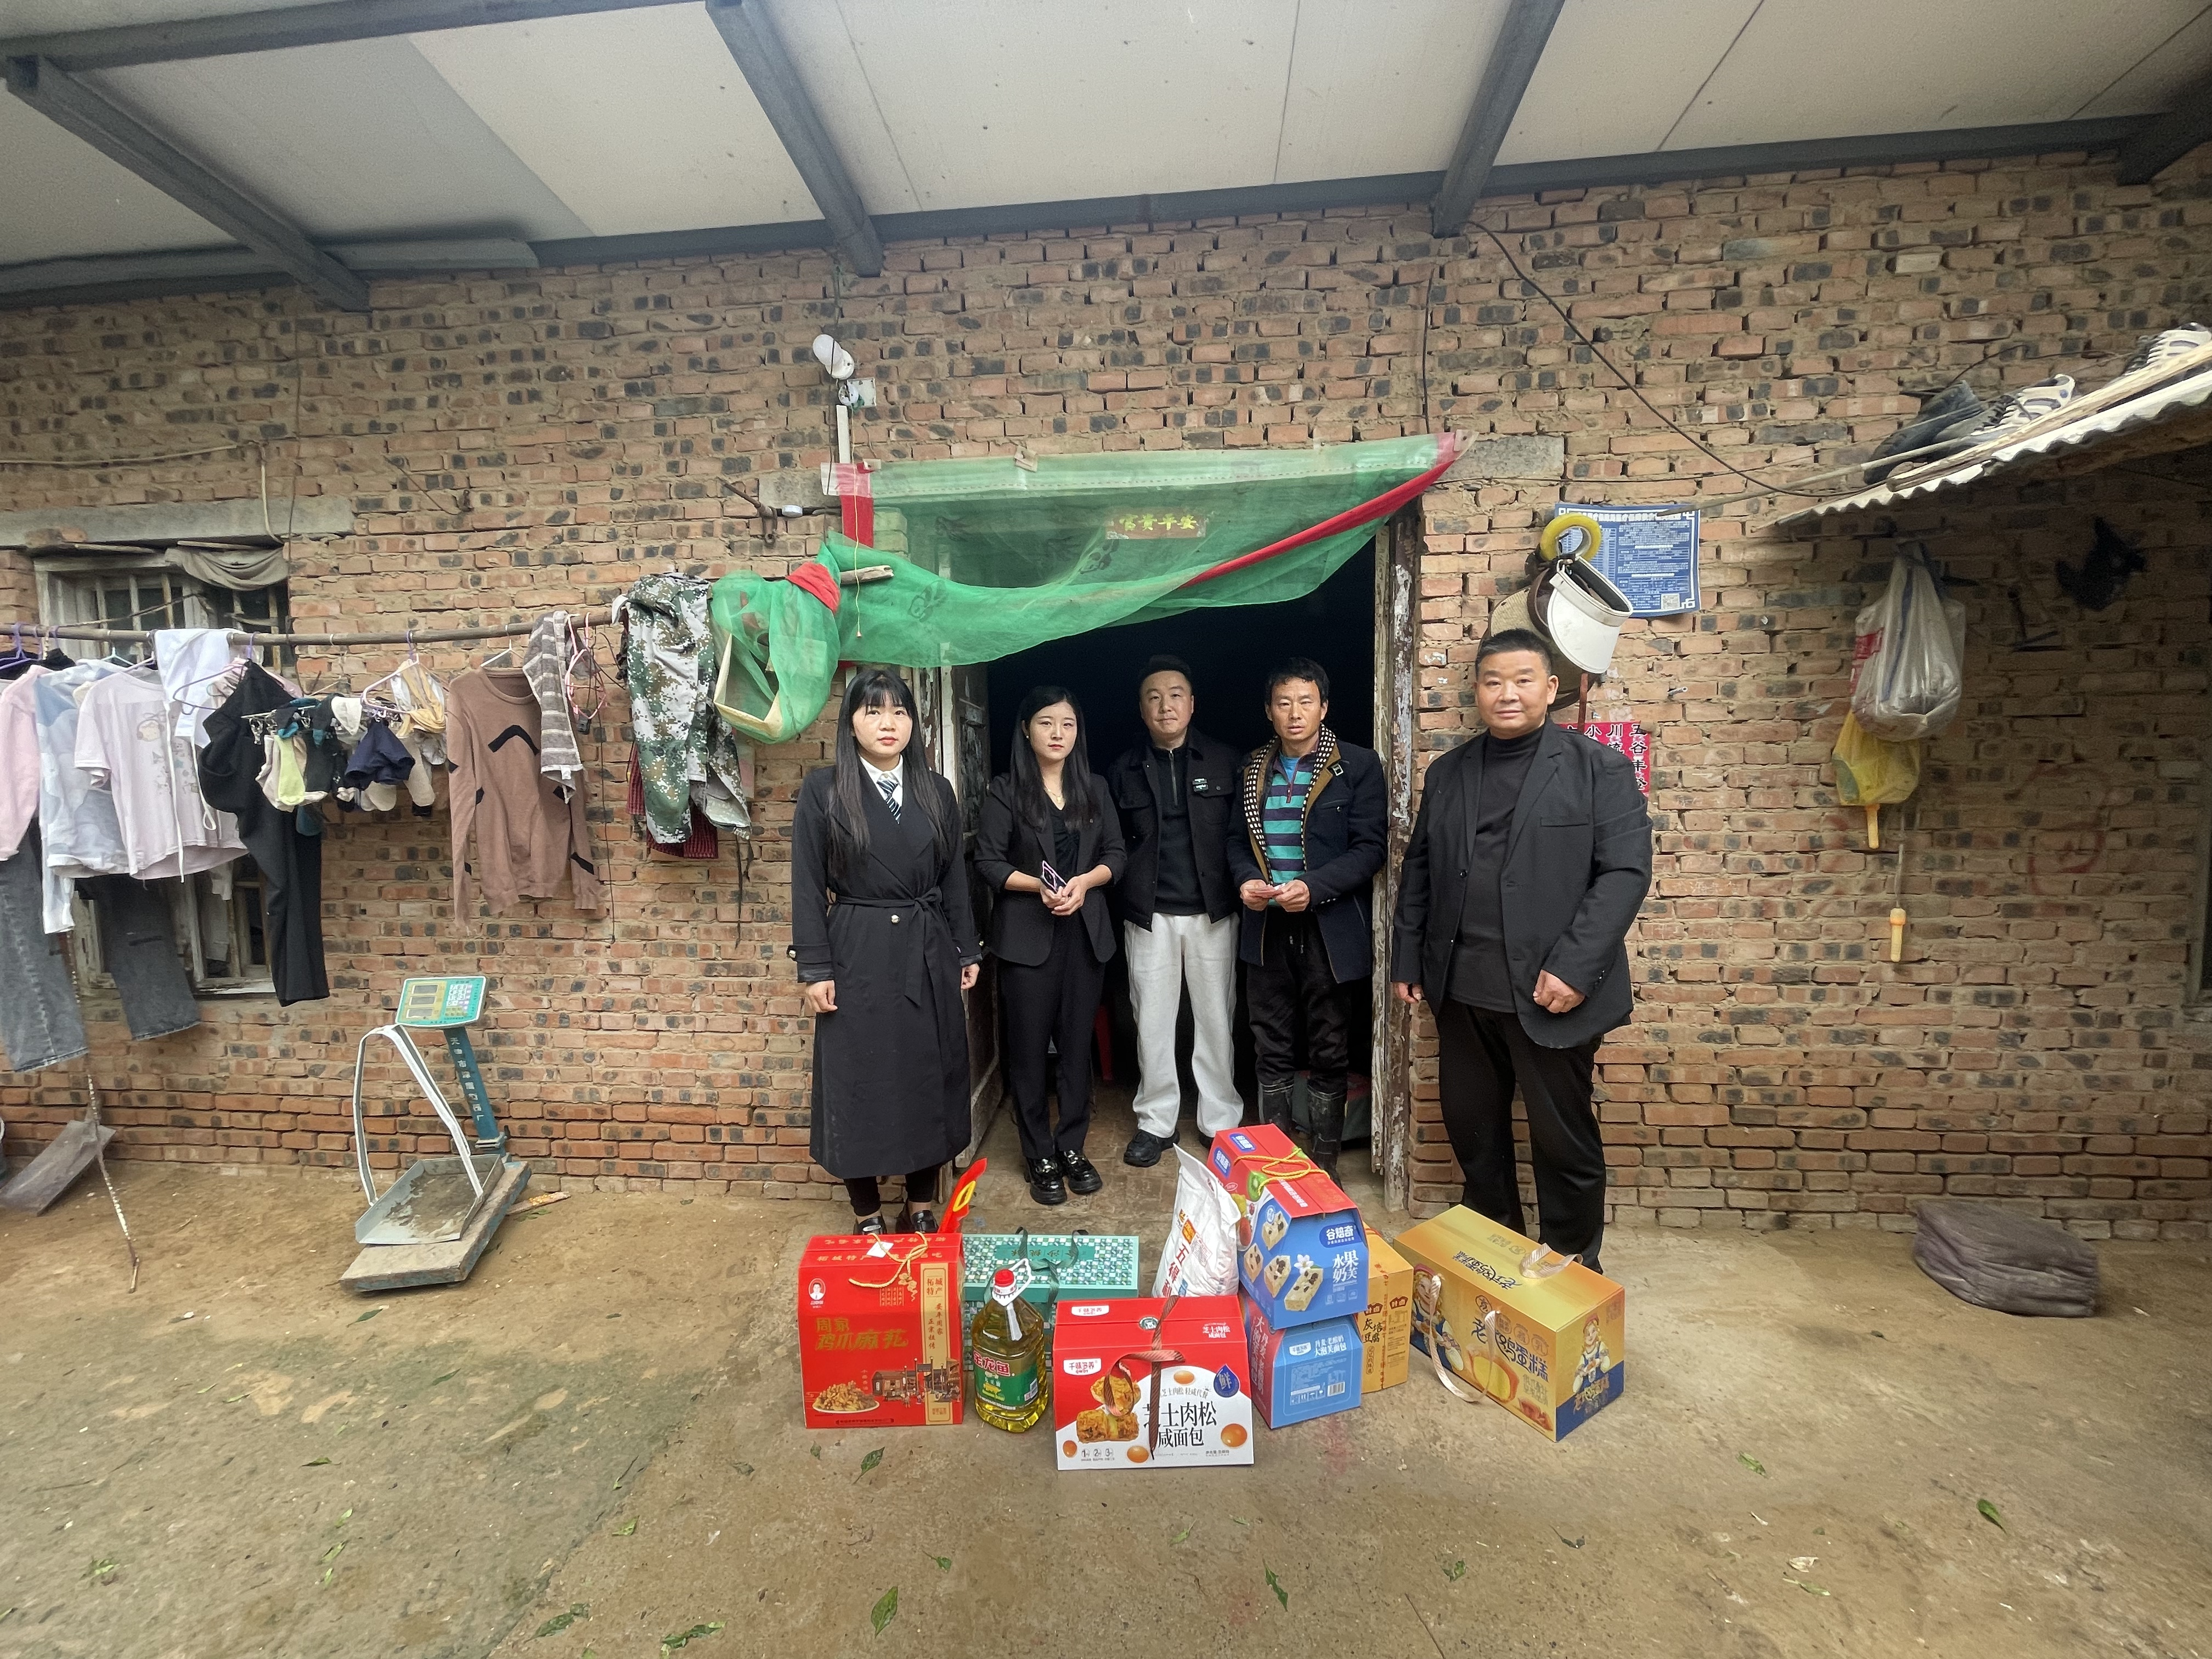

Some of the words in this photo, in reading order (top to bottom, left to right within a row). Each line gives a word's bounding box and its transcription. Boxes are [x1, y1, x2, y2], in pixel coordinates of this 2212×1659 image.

[1333, 1250, 1359, 1268] 水果
[973, 1350, 1011, 1376] 金龙鱼
[1219, 1372, 1232, 1390] 鲜
[1158, 1427, 1204, 1448] 咸面包
